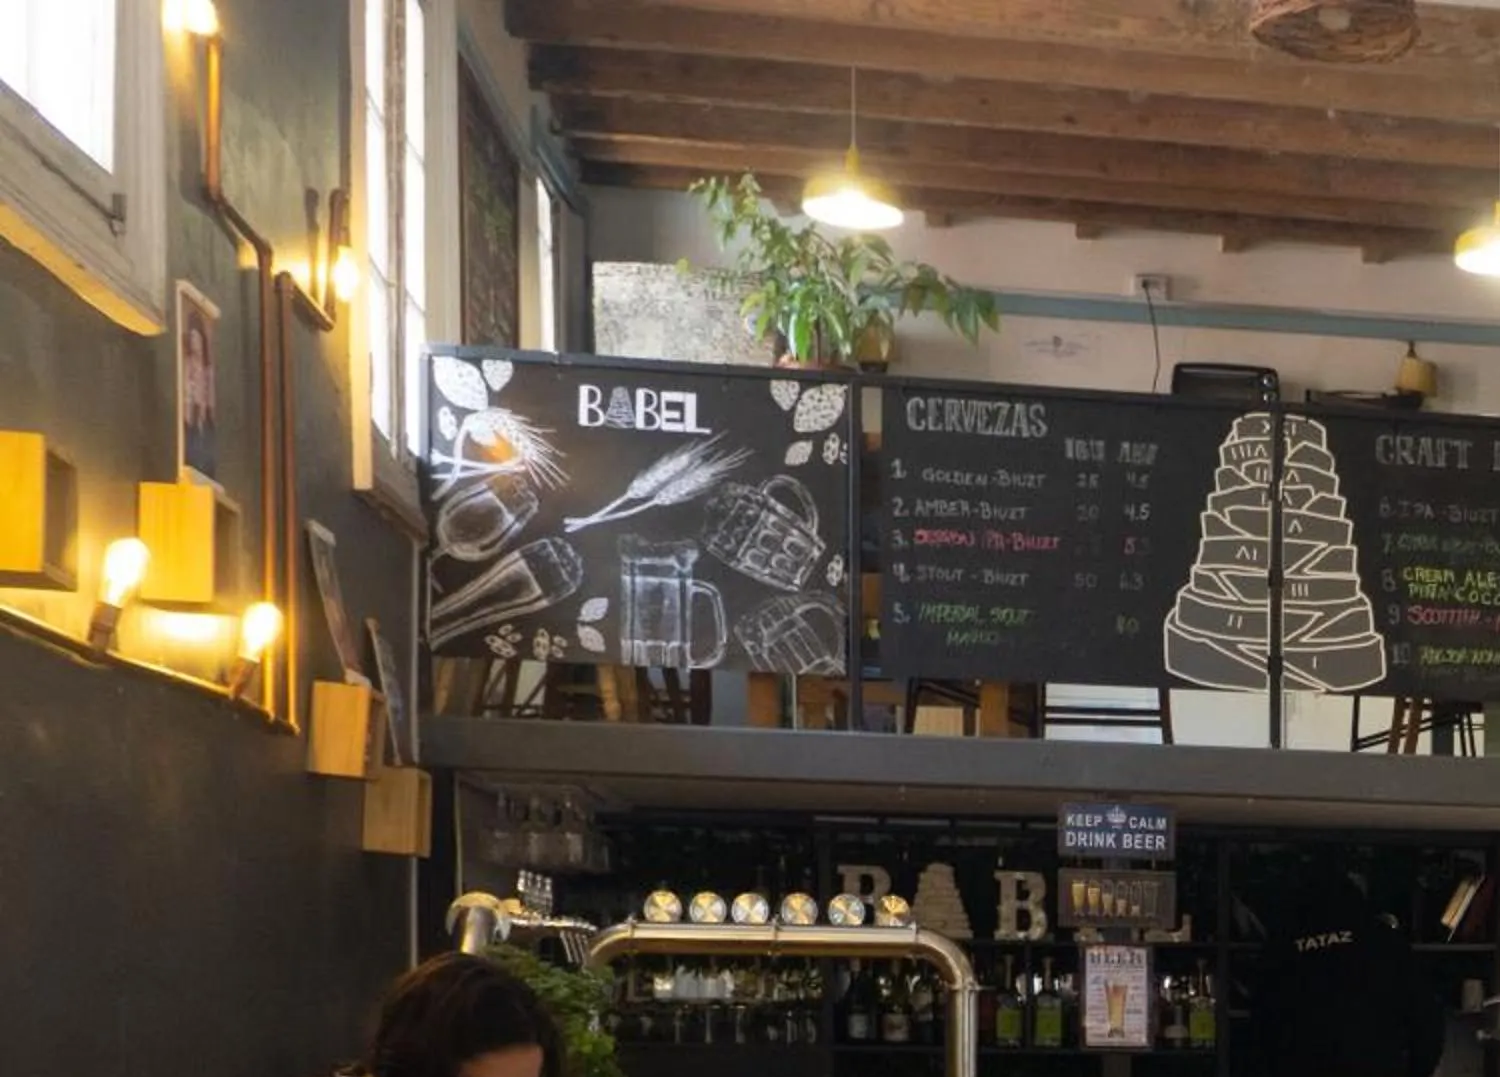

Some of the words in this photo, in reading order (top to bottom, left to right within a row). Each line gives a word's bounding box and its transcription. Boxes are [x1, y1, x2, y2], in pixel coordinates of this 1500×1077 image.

[578, 384, 712, 435] BABEL
[906, 396, 1048, 438] CERVEZAS
[1375, 434, 1473, 469] CRAFT
[1403, 566, 1456, 584] CREAM
[1463, 570, 1497, 589] ALE
[1066, 813, 1103, 827] KEEP
[1129, 814, 1167, 830] CALM
[1065, 831, 1116, 849] DRINK
[1122, 832, 1167, 851] BEER
[1293, 929, 1354, 953] TATAZ
